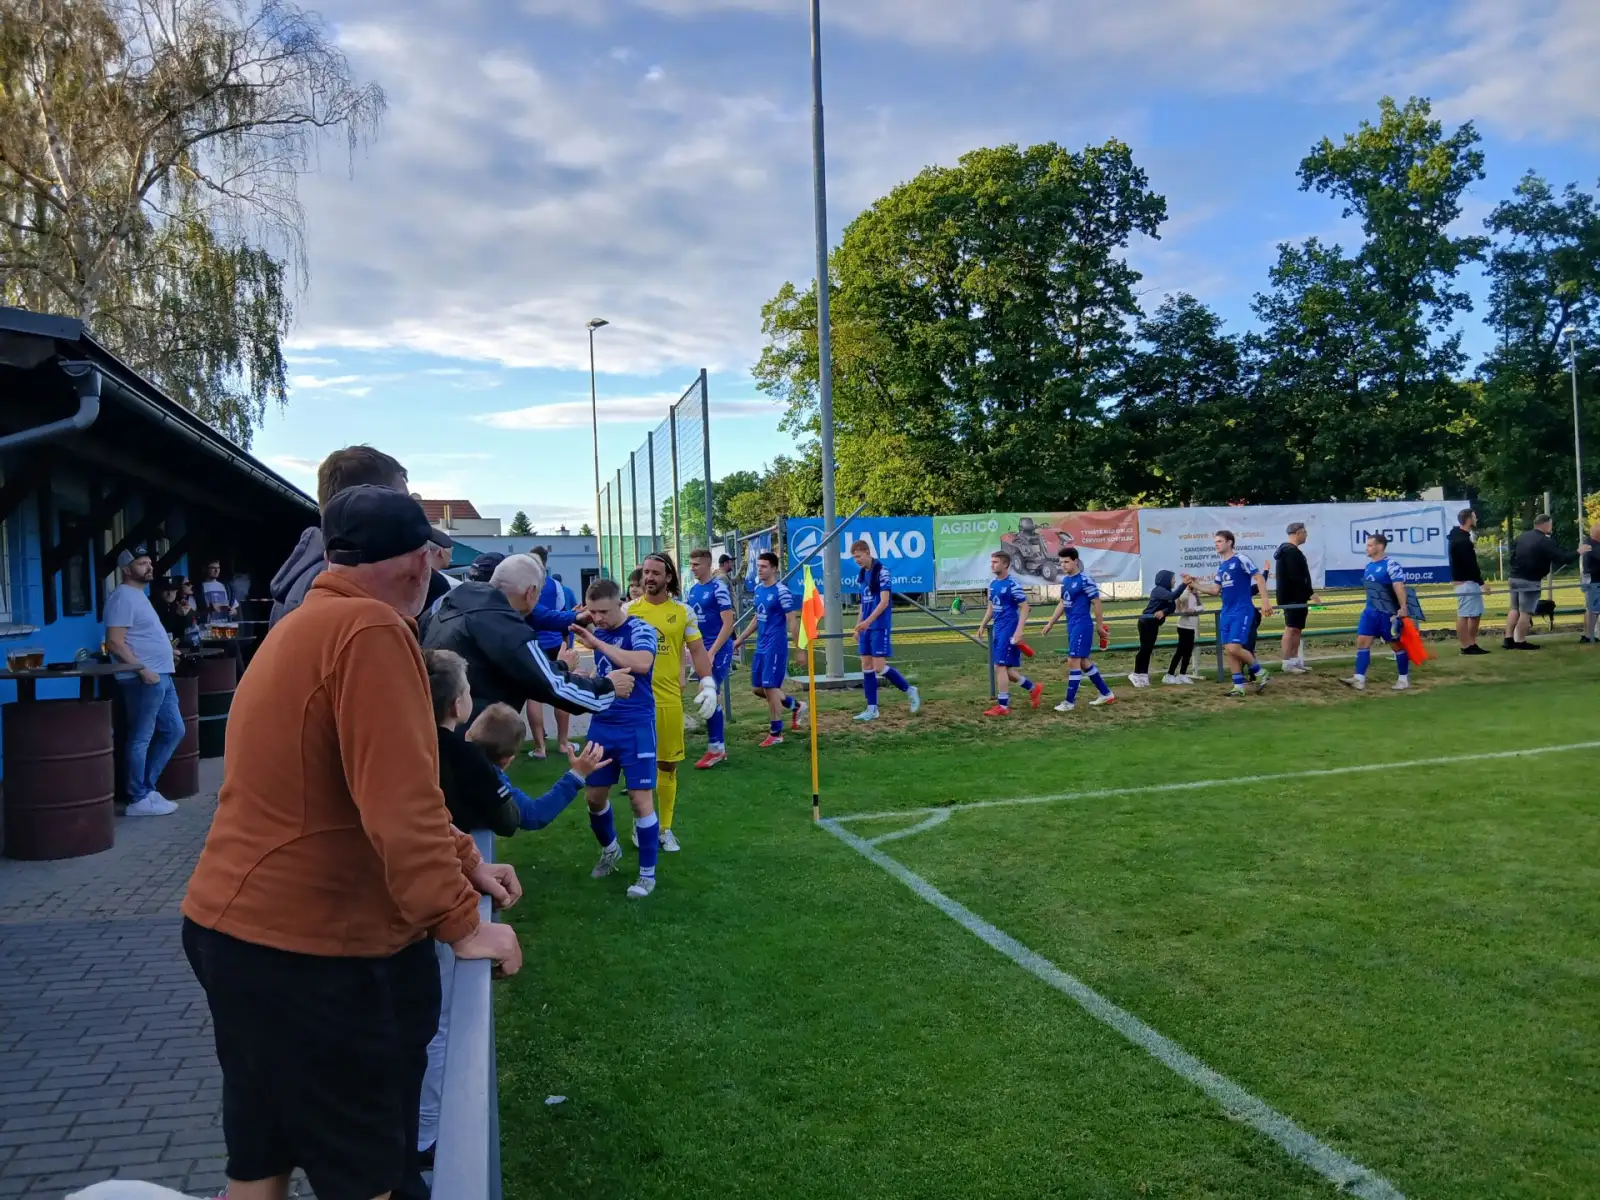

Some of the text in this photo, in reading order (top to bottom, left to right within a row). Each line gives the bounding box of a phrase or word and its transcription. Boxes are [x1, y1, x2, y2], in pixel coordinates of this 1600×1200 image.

[941, 519, 999, 535] AGRICO
[1356, 527, 1440, 544] INGTOP
[840, 530, 926, 560] JAKO
